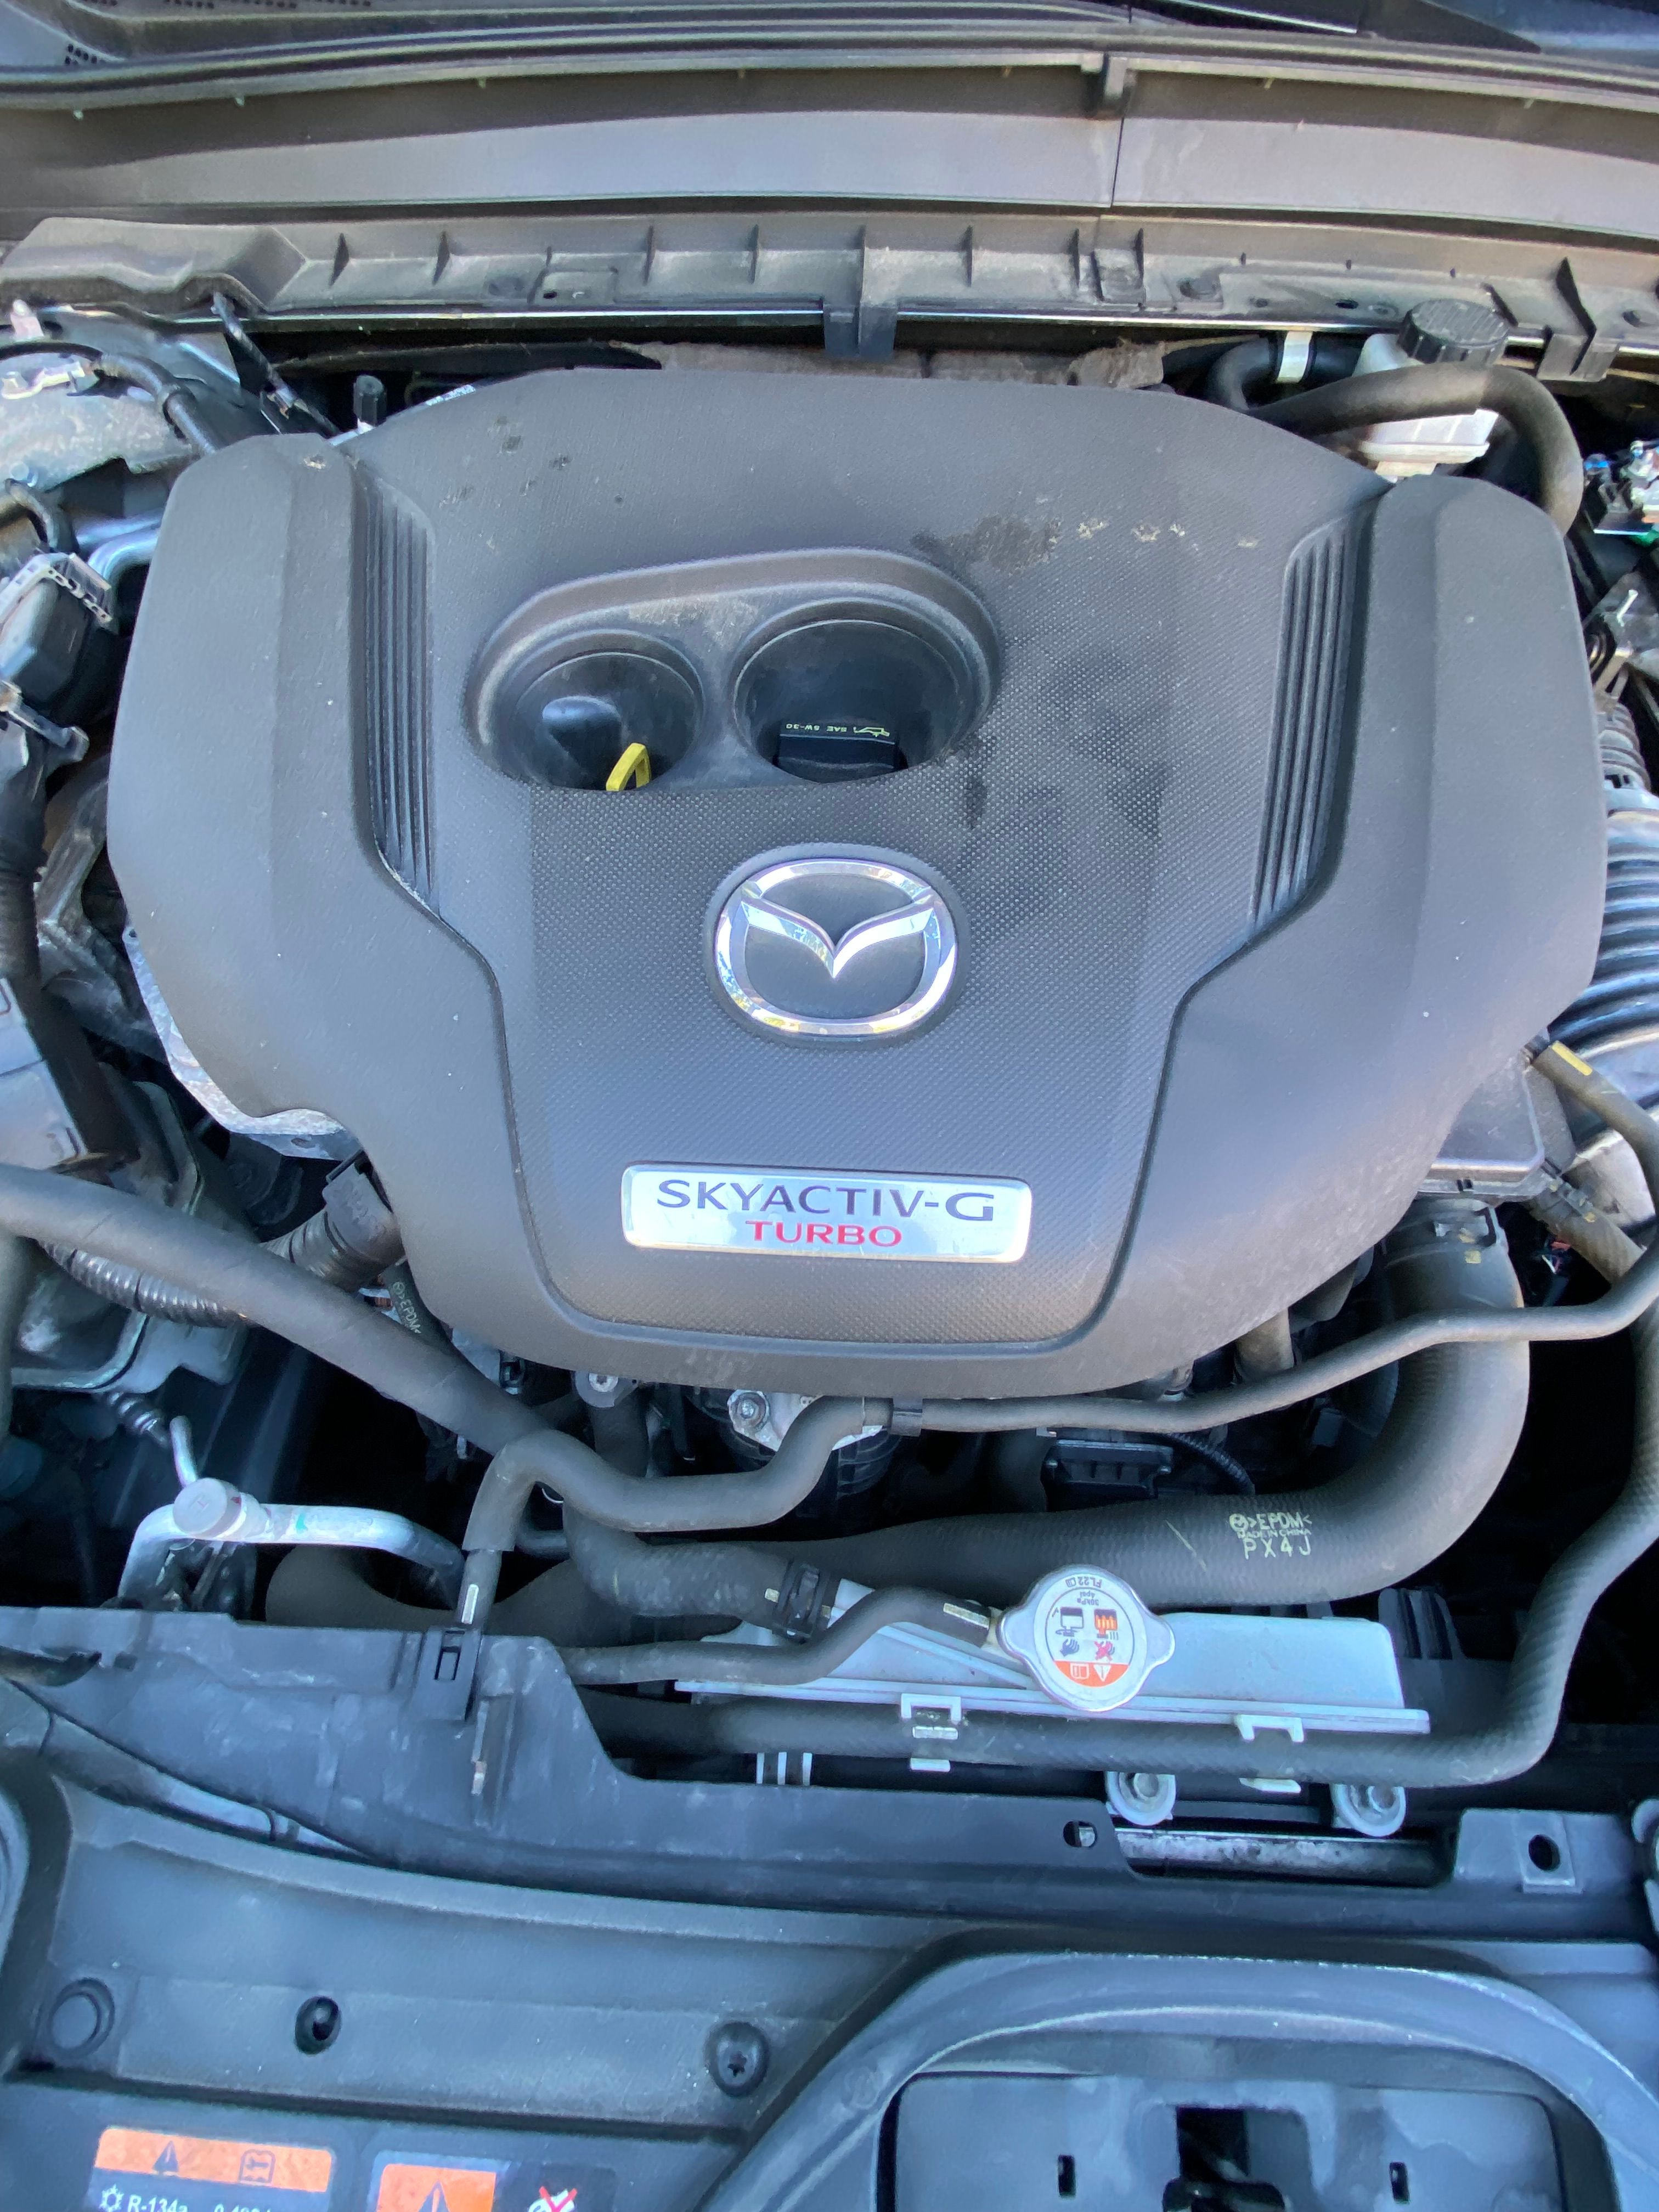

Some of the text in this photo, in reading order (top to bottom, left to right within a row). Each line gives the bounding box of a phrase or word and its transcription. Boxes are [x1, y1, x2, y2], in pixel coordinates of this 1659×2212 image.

[657, 1179, 994, 1221] SKYACTIV-G
[746, 1220, 902, 1248] TURBO
[1077, 1577, 1102, 1588] FL22
